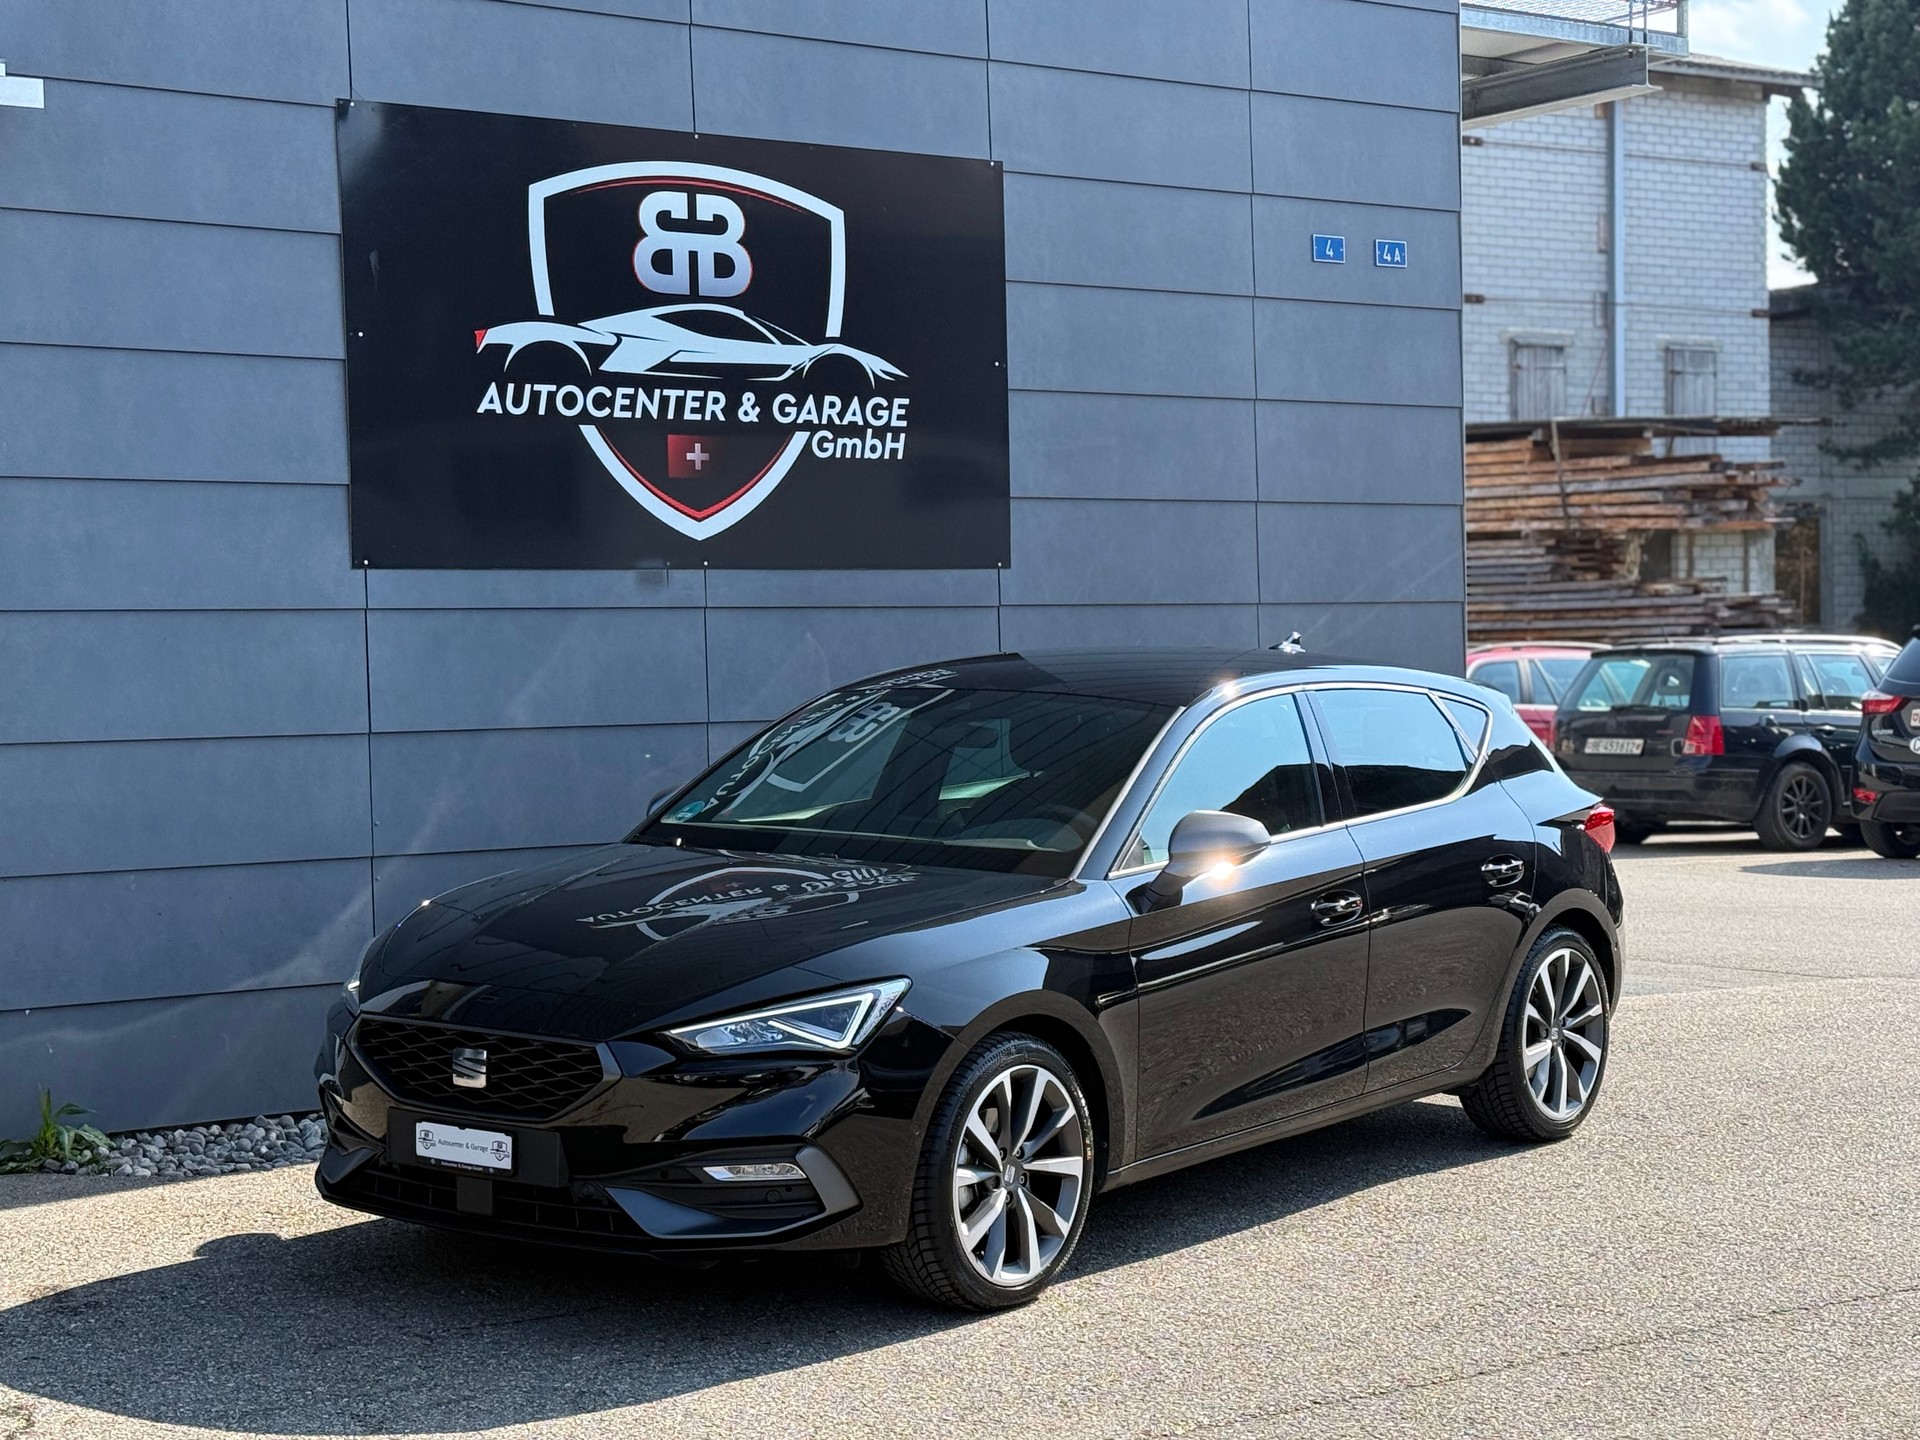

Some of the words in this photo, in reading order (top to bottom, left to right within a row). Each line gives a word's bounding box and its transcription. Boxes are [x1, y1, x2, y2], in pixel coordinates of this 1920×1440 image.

[1325, 239, 1334, 258] 4
[1383, 244, 1401, 263] 4A
[476, 381, 726, 421] AUTOCENTER
[737, 391, 761, 422] &
[772, 393, 910, 427] GARAGE
[811, 428, 906, 460] GmbH
